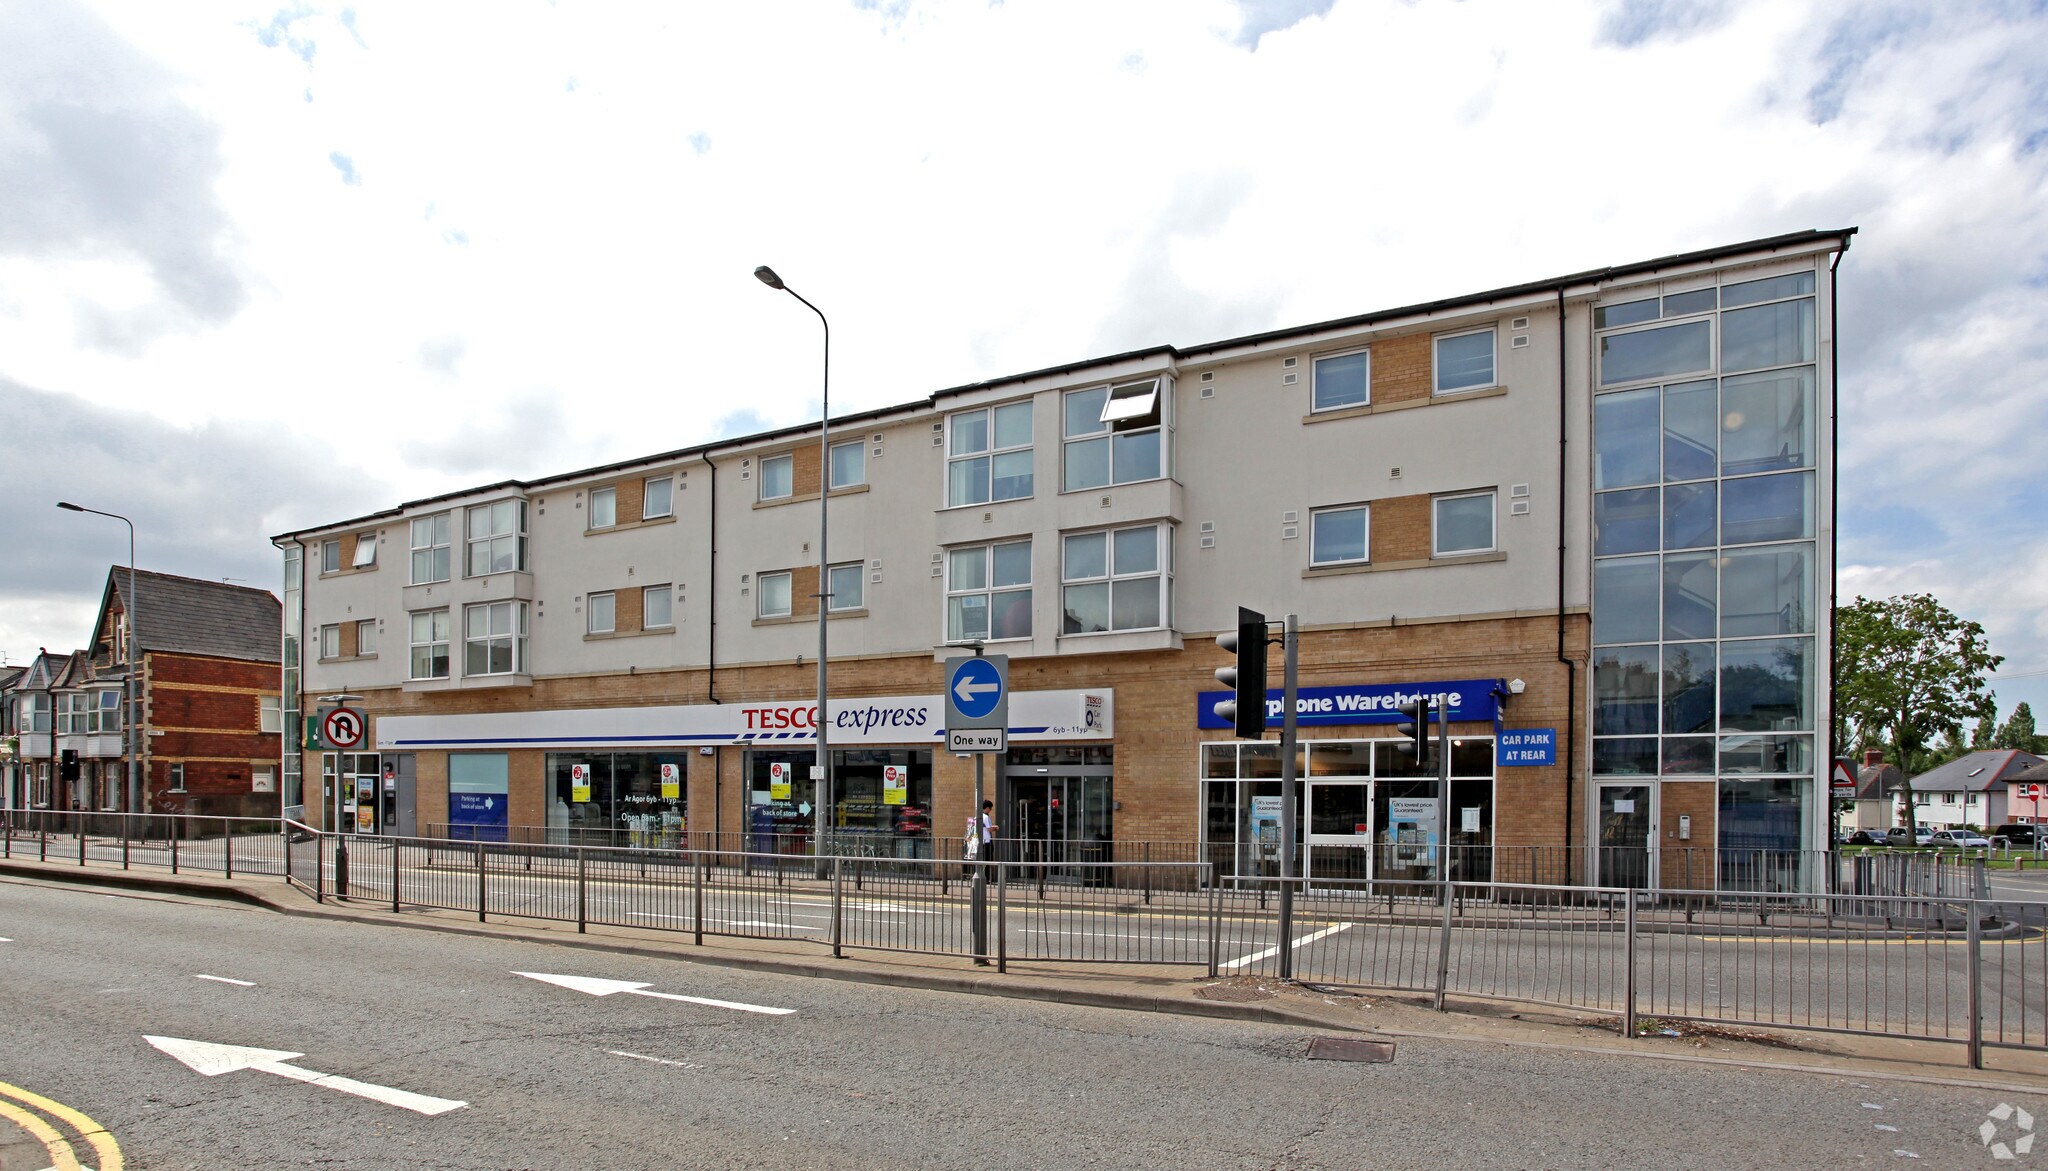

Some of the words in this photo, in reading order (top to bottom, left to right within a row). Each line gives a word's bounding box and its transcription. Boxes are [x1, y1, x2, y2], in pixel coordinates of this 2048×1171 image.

[1087, 696, 1101, 704] TESCO
[837, 706, 927, 735] express
[1053, 726, 1065, 734] 6yb
[1072, 726, 1088, 734] 11yp
[954, 735, 973, 745] One
[978, 737, 998, 746] way
[1502, 735, 1521, 745] CAR
[1524, 734, 1549, 745] PARK
[1506, 750, 1518, 760] AT
[1521, 750, 1545, 760] REAR
[632, 795, 645, 804] Agor
[621, 812, 639, 822] Open
